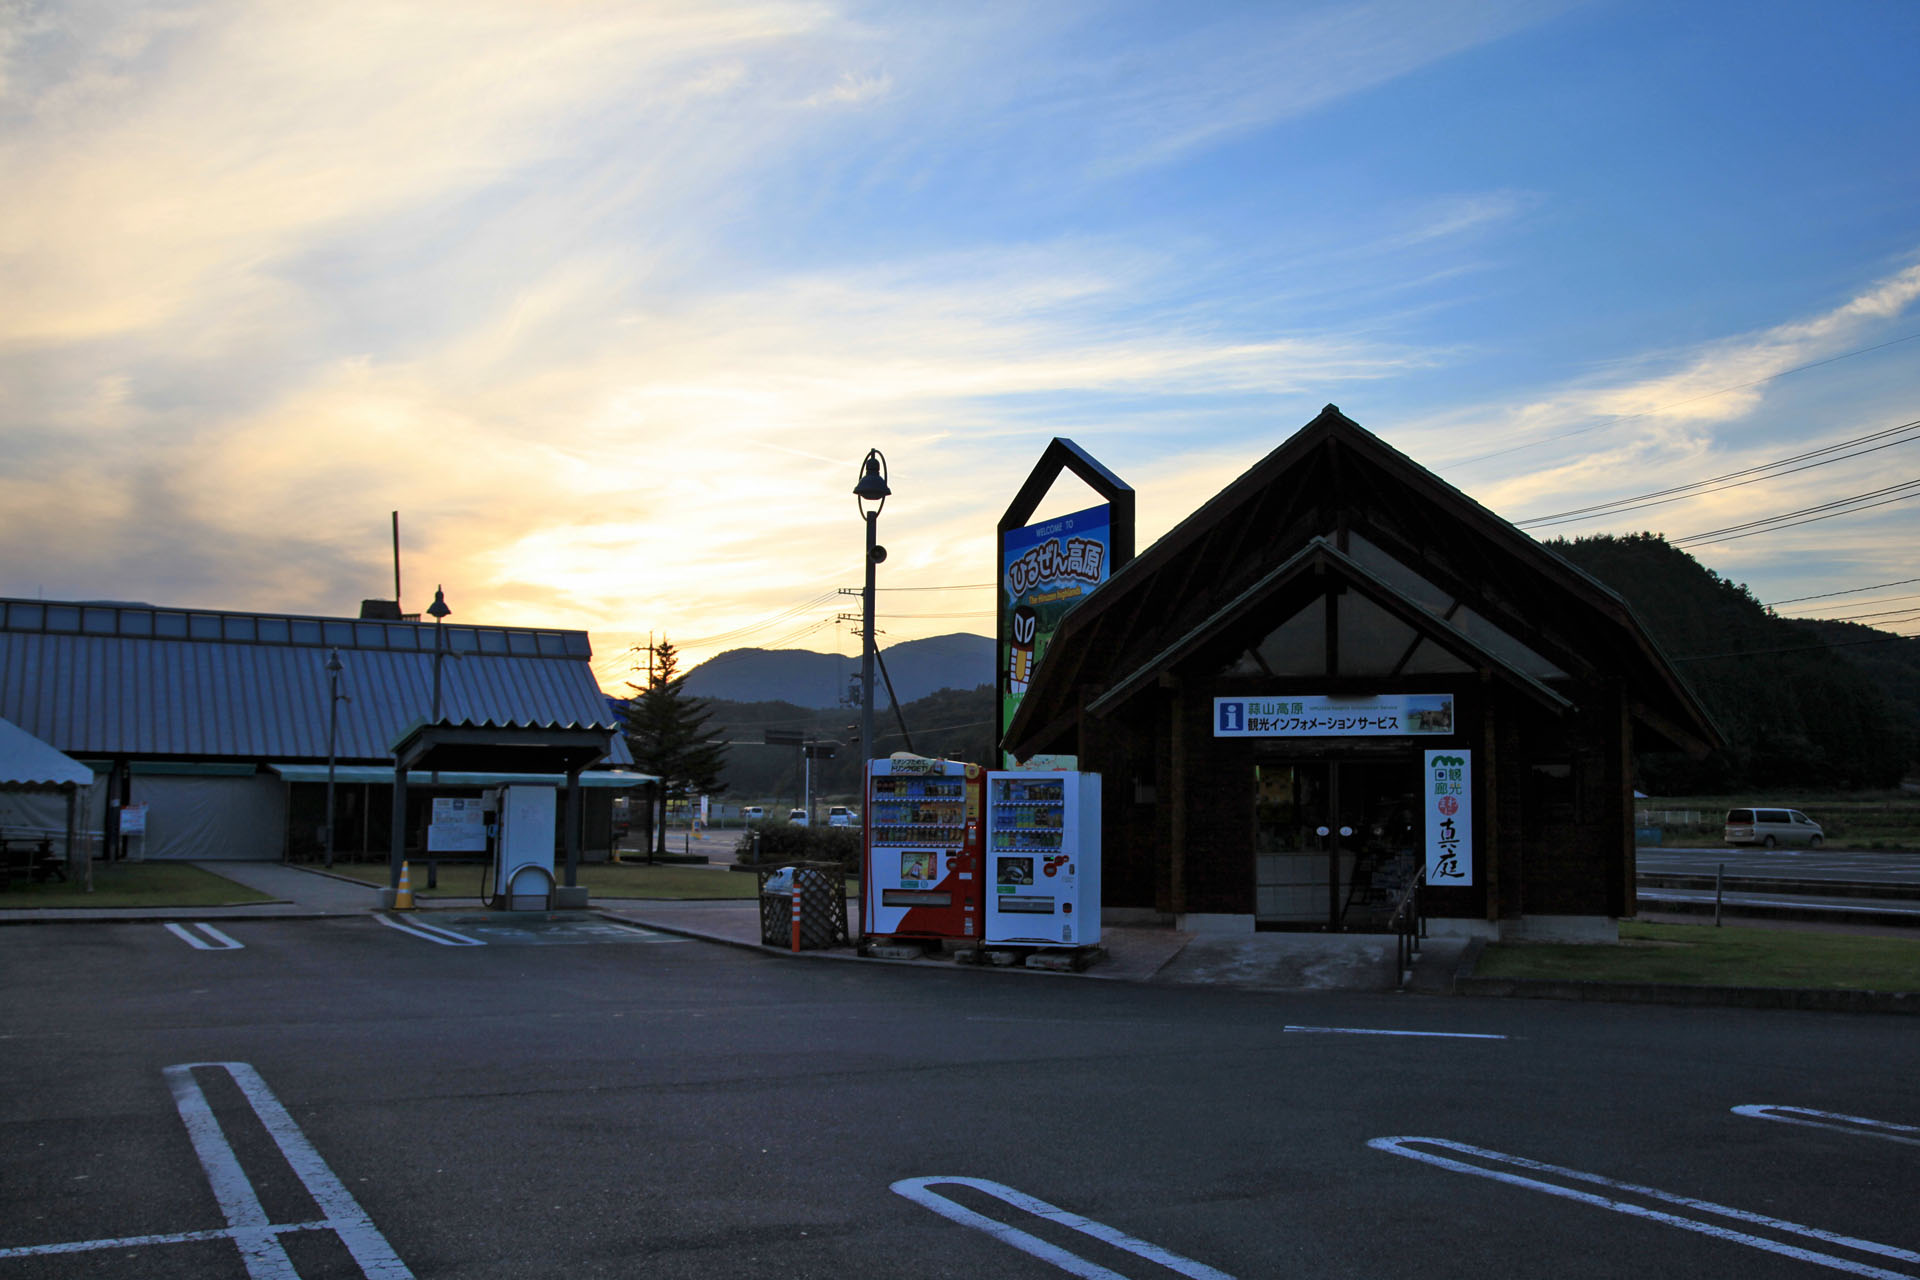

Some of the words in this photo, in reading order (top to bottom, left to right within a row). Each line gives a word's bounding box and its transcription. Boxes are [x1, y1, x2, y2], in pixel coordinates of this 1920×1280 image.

[1036, 522, 1063, 537] WELCOME
[1065, 520, 1074, 529] TO
[1009, 538, 1103, 594] ひるぜん高原
[1248, 702, 1304, 715] 蒜山高原
[1248, 717, 1399, 732] 観光インフォメーションサービス
[1432, 817, 1465, 879] 真庭
